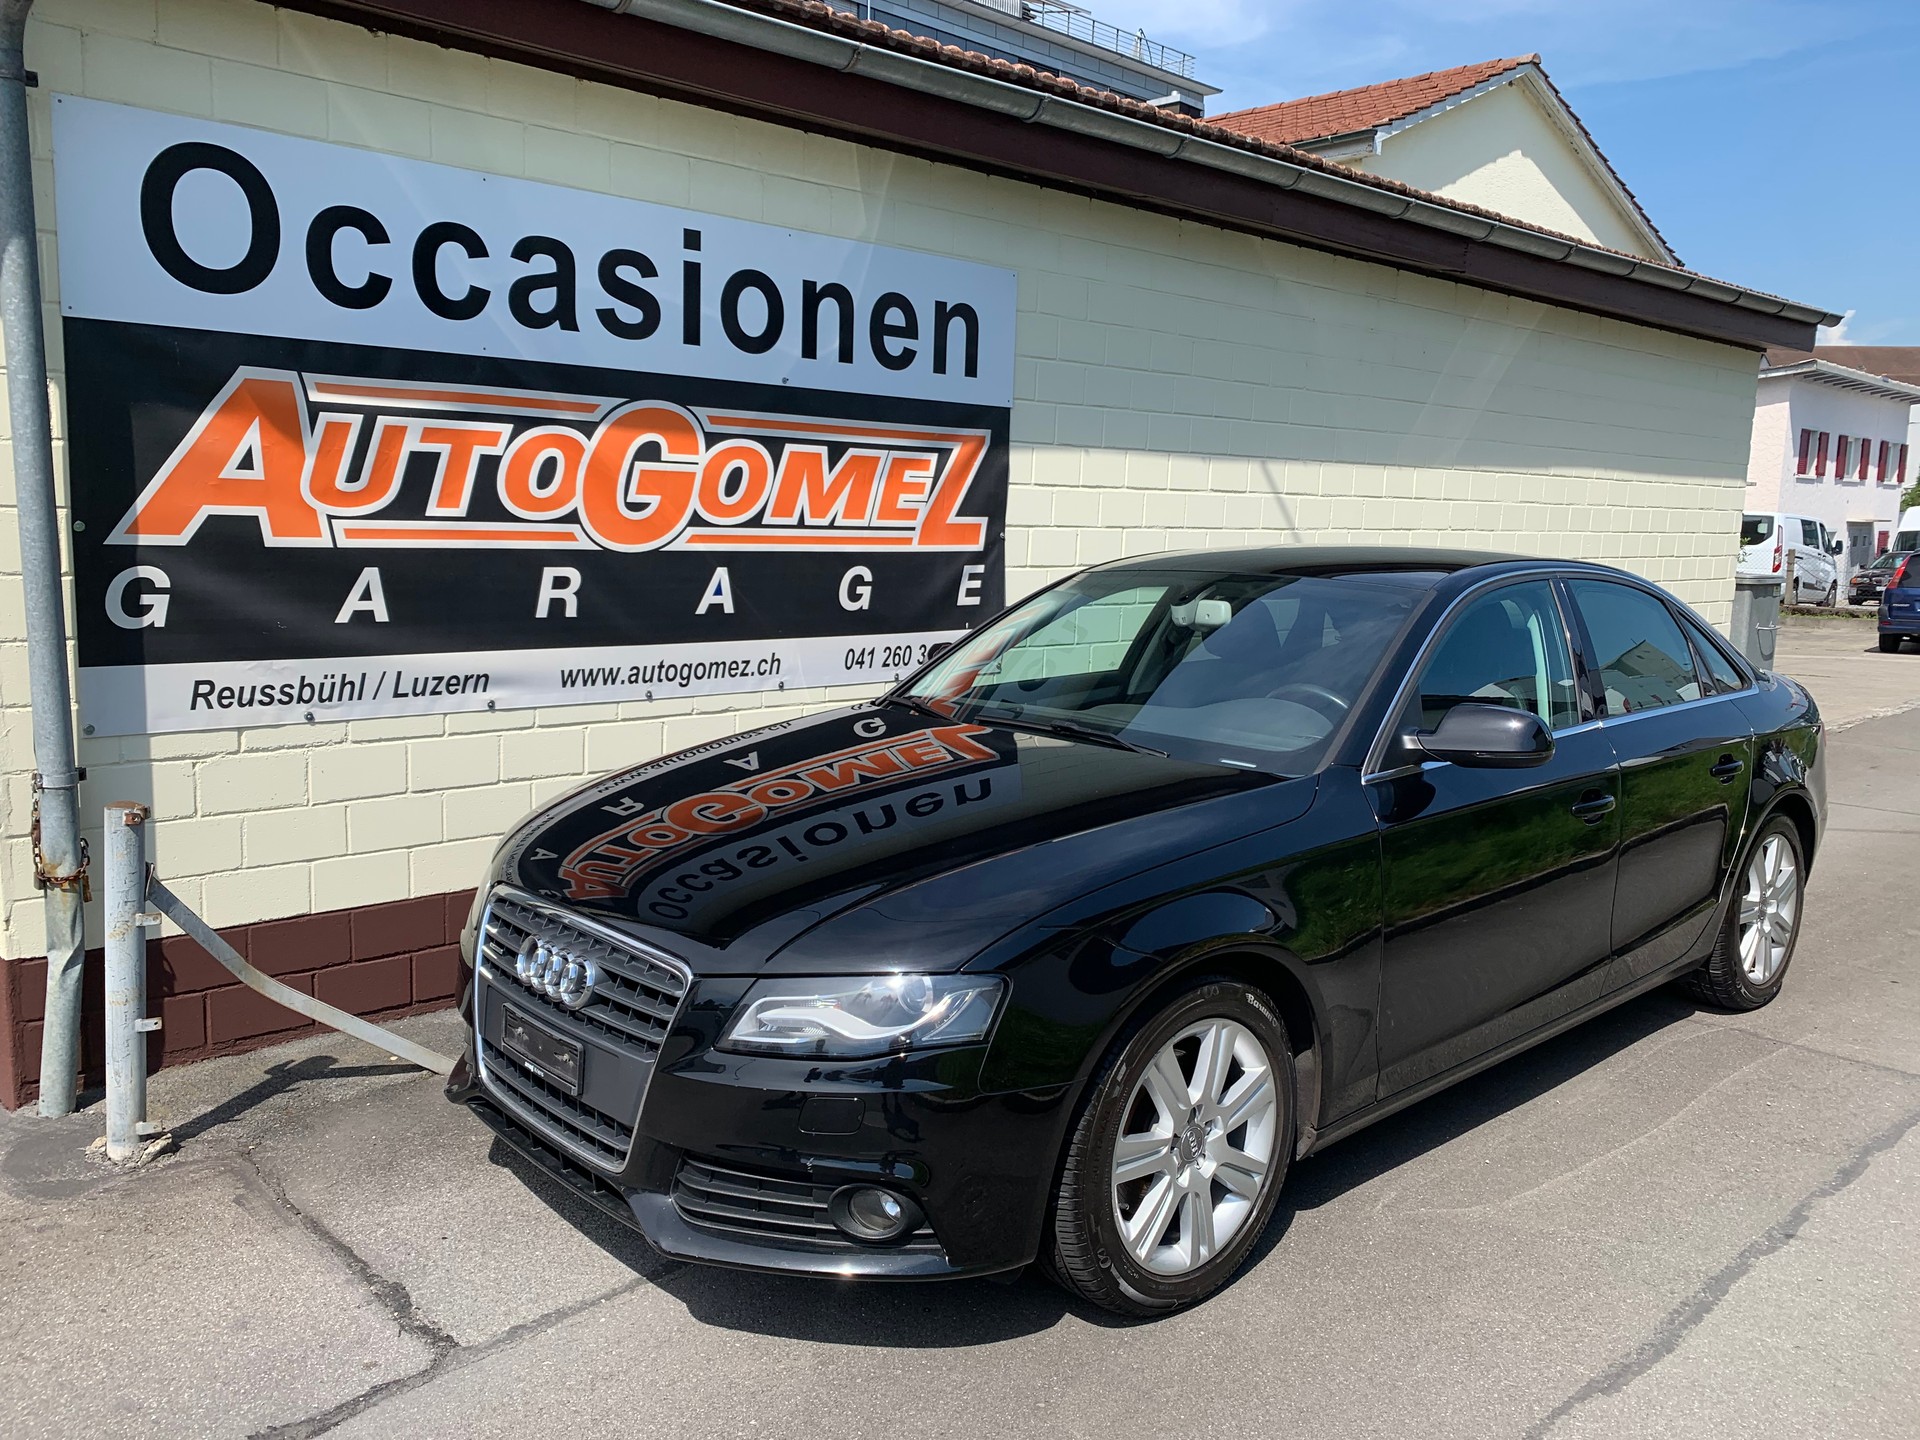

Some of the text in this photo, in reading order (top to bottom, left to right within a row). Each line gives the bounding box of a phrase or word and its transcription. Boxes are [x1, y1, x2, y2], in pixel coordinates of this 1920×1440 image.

[140, 141, 980, 379] Occasionen
[190, 672, 367, 711] Reussbühl
[392, 671, 490, 698] Luzern
[560, 652, 782, 688] www.autogomez.ch
[844, 647, 876, 670] 041
[882, 644, 912, 668] 260
[1245, 993, 1272, 1022] Barum
